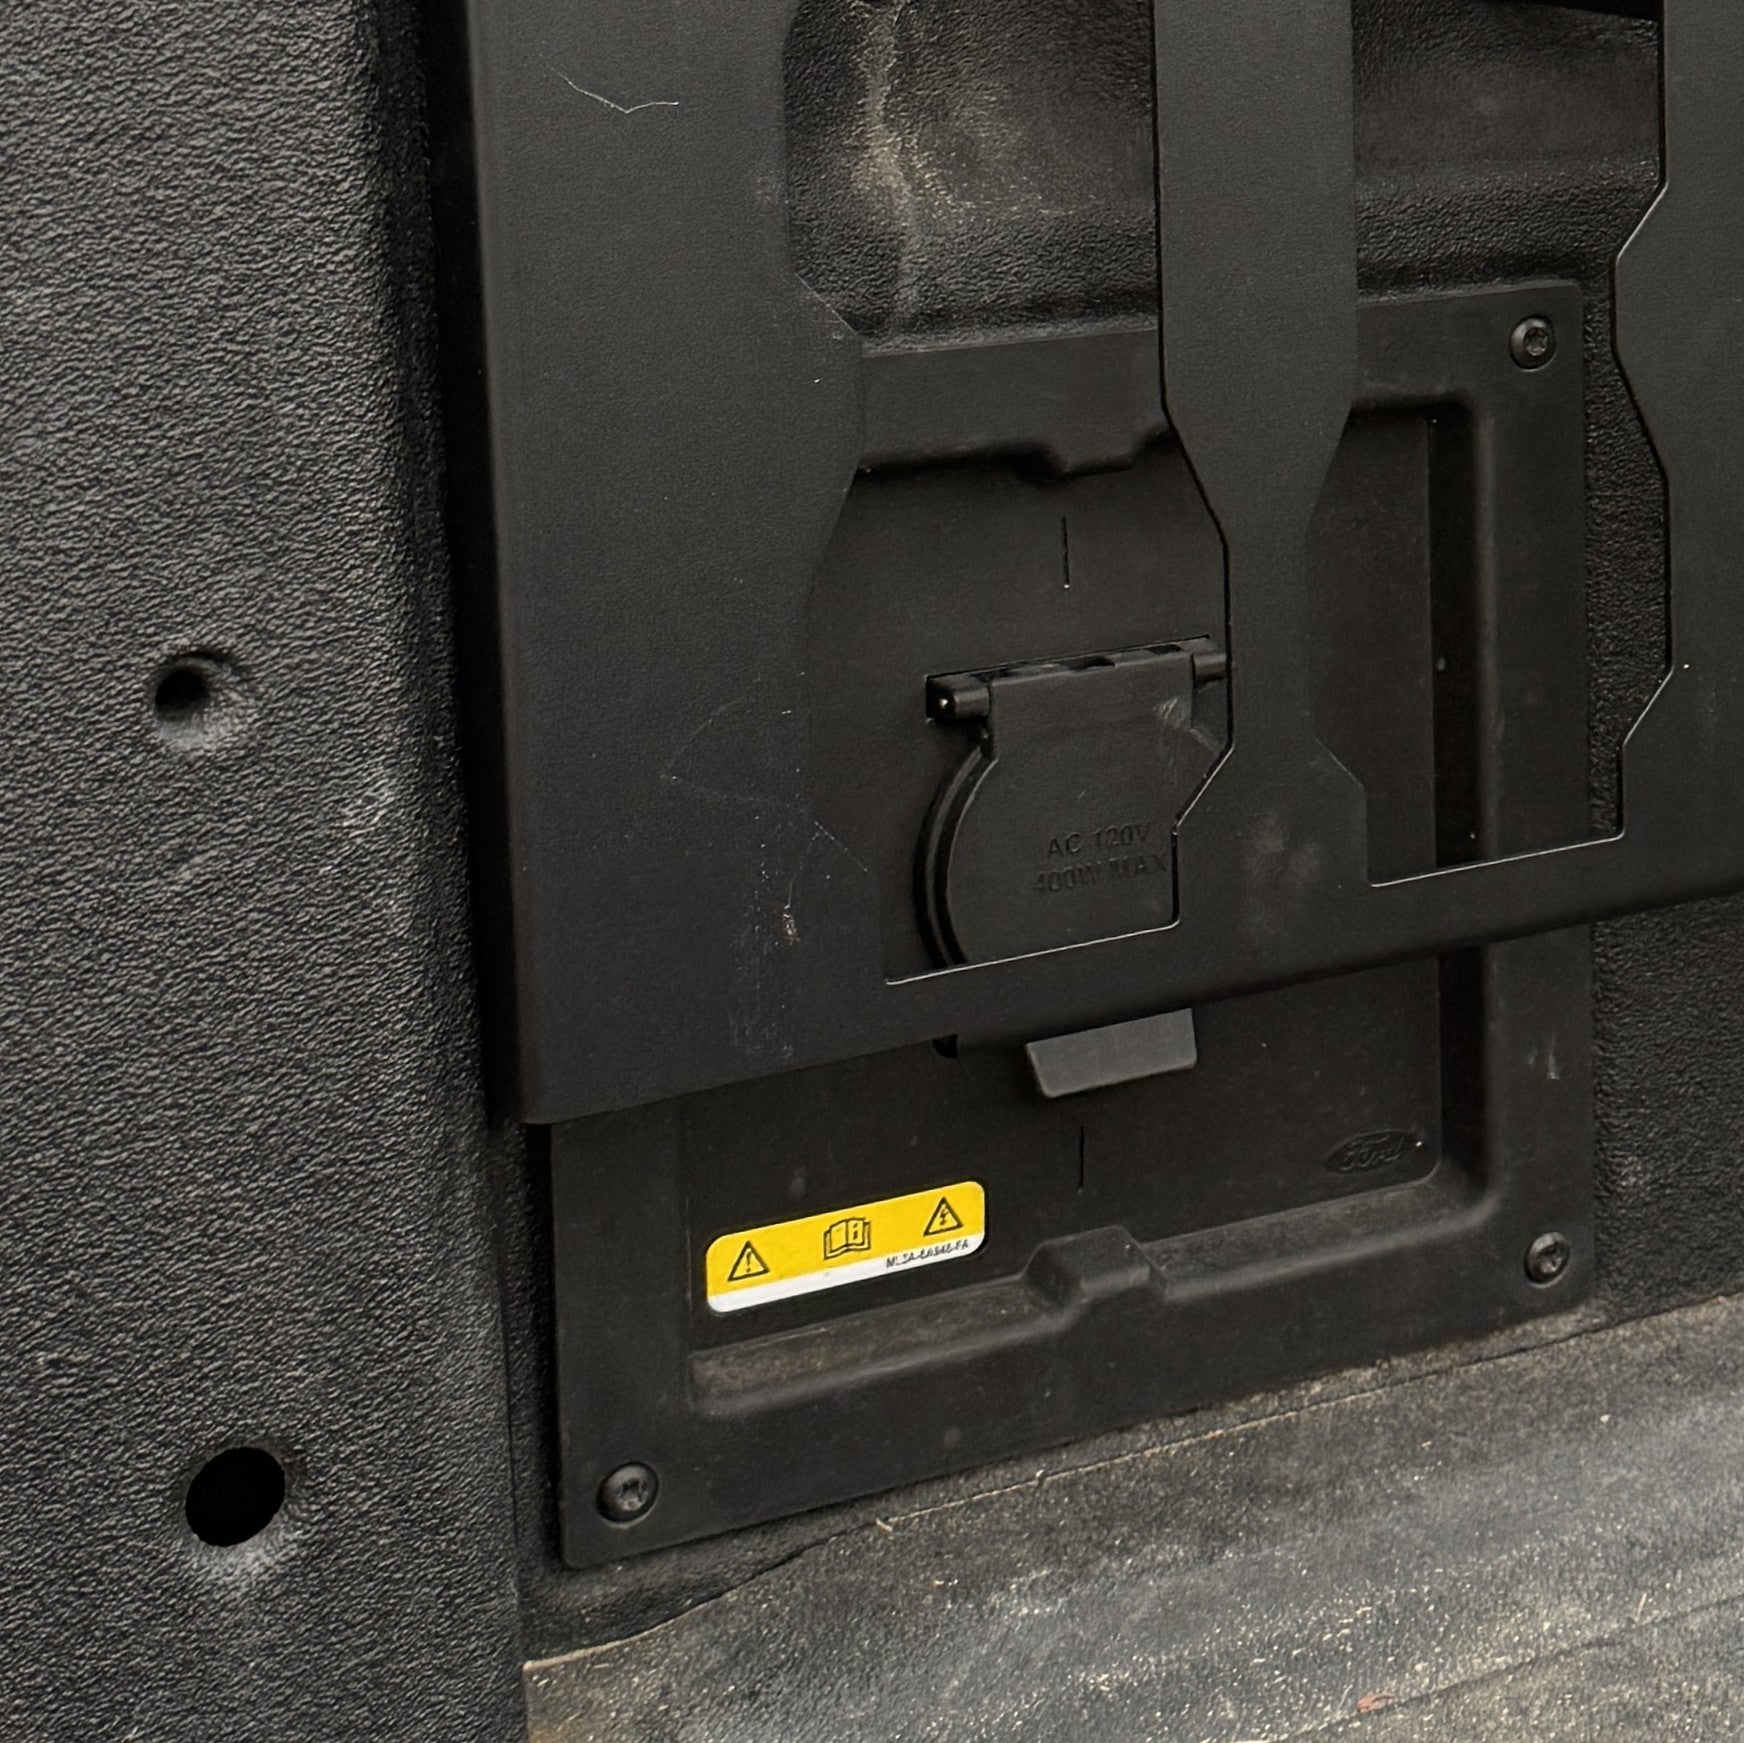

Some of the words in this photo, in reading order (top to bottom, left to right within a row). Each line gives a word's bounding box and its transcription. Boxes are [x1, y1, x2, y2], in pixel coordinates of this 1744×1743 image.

[1047, 832, 1082, 858] AC
[1092, 821, 1152, 848] 120V
[1108, 852, 1168, 882] MAX
